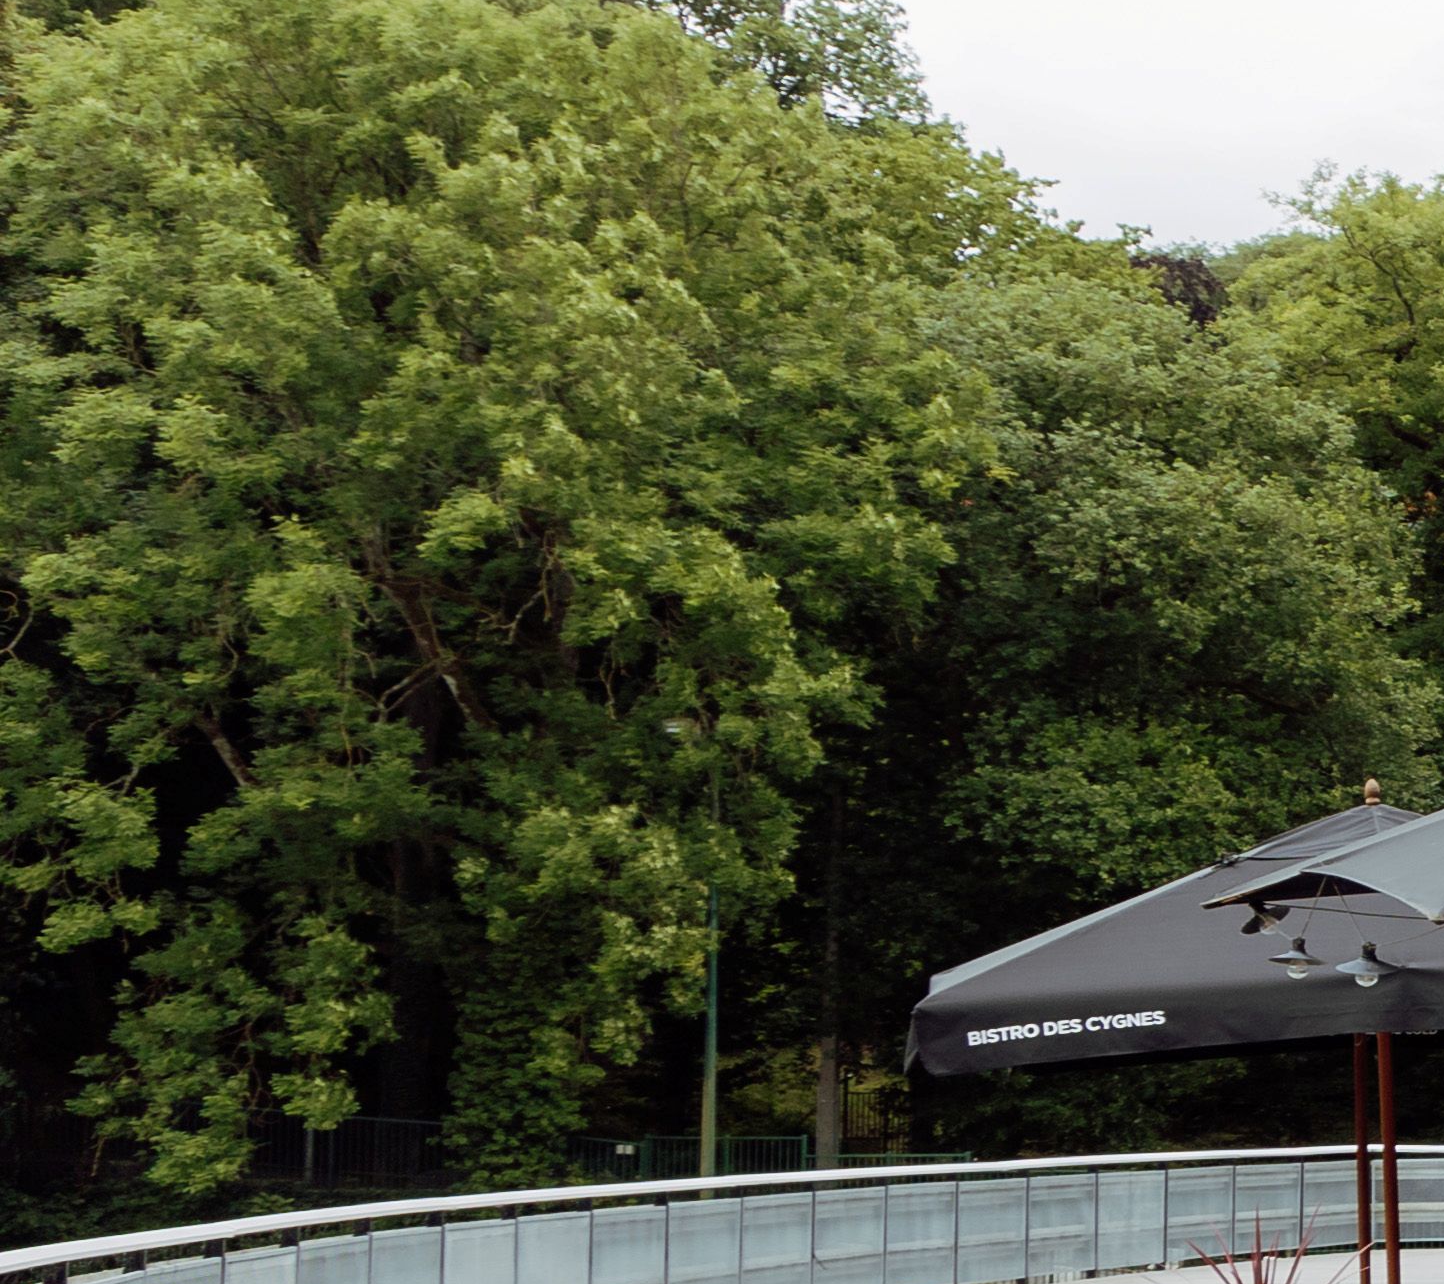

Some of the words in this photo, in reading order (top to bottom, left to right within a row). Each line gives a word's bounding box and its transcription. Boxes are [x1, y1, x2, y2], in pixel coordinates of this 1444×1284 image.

[966, 1023, 1040, 1046] BISTRO
[1042, 1018, 1083, 1037] DES
[1085, 1010, 1167, 1032] CYGNES
